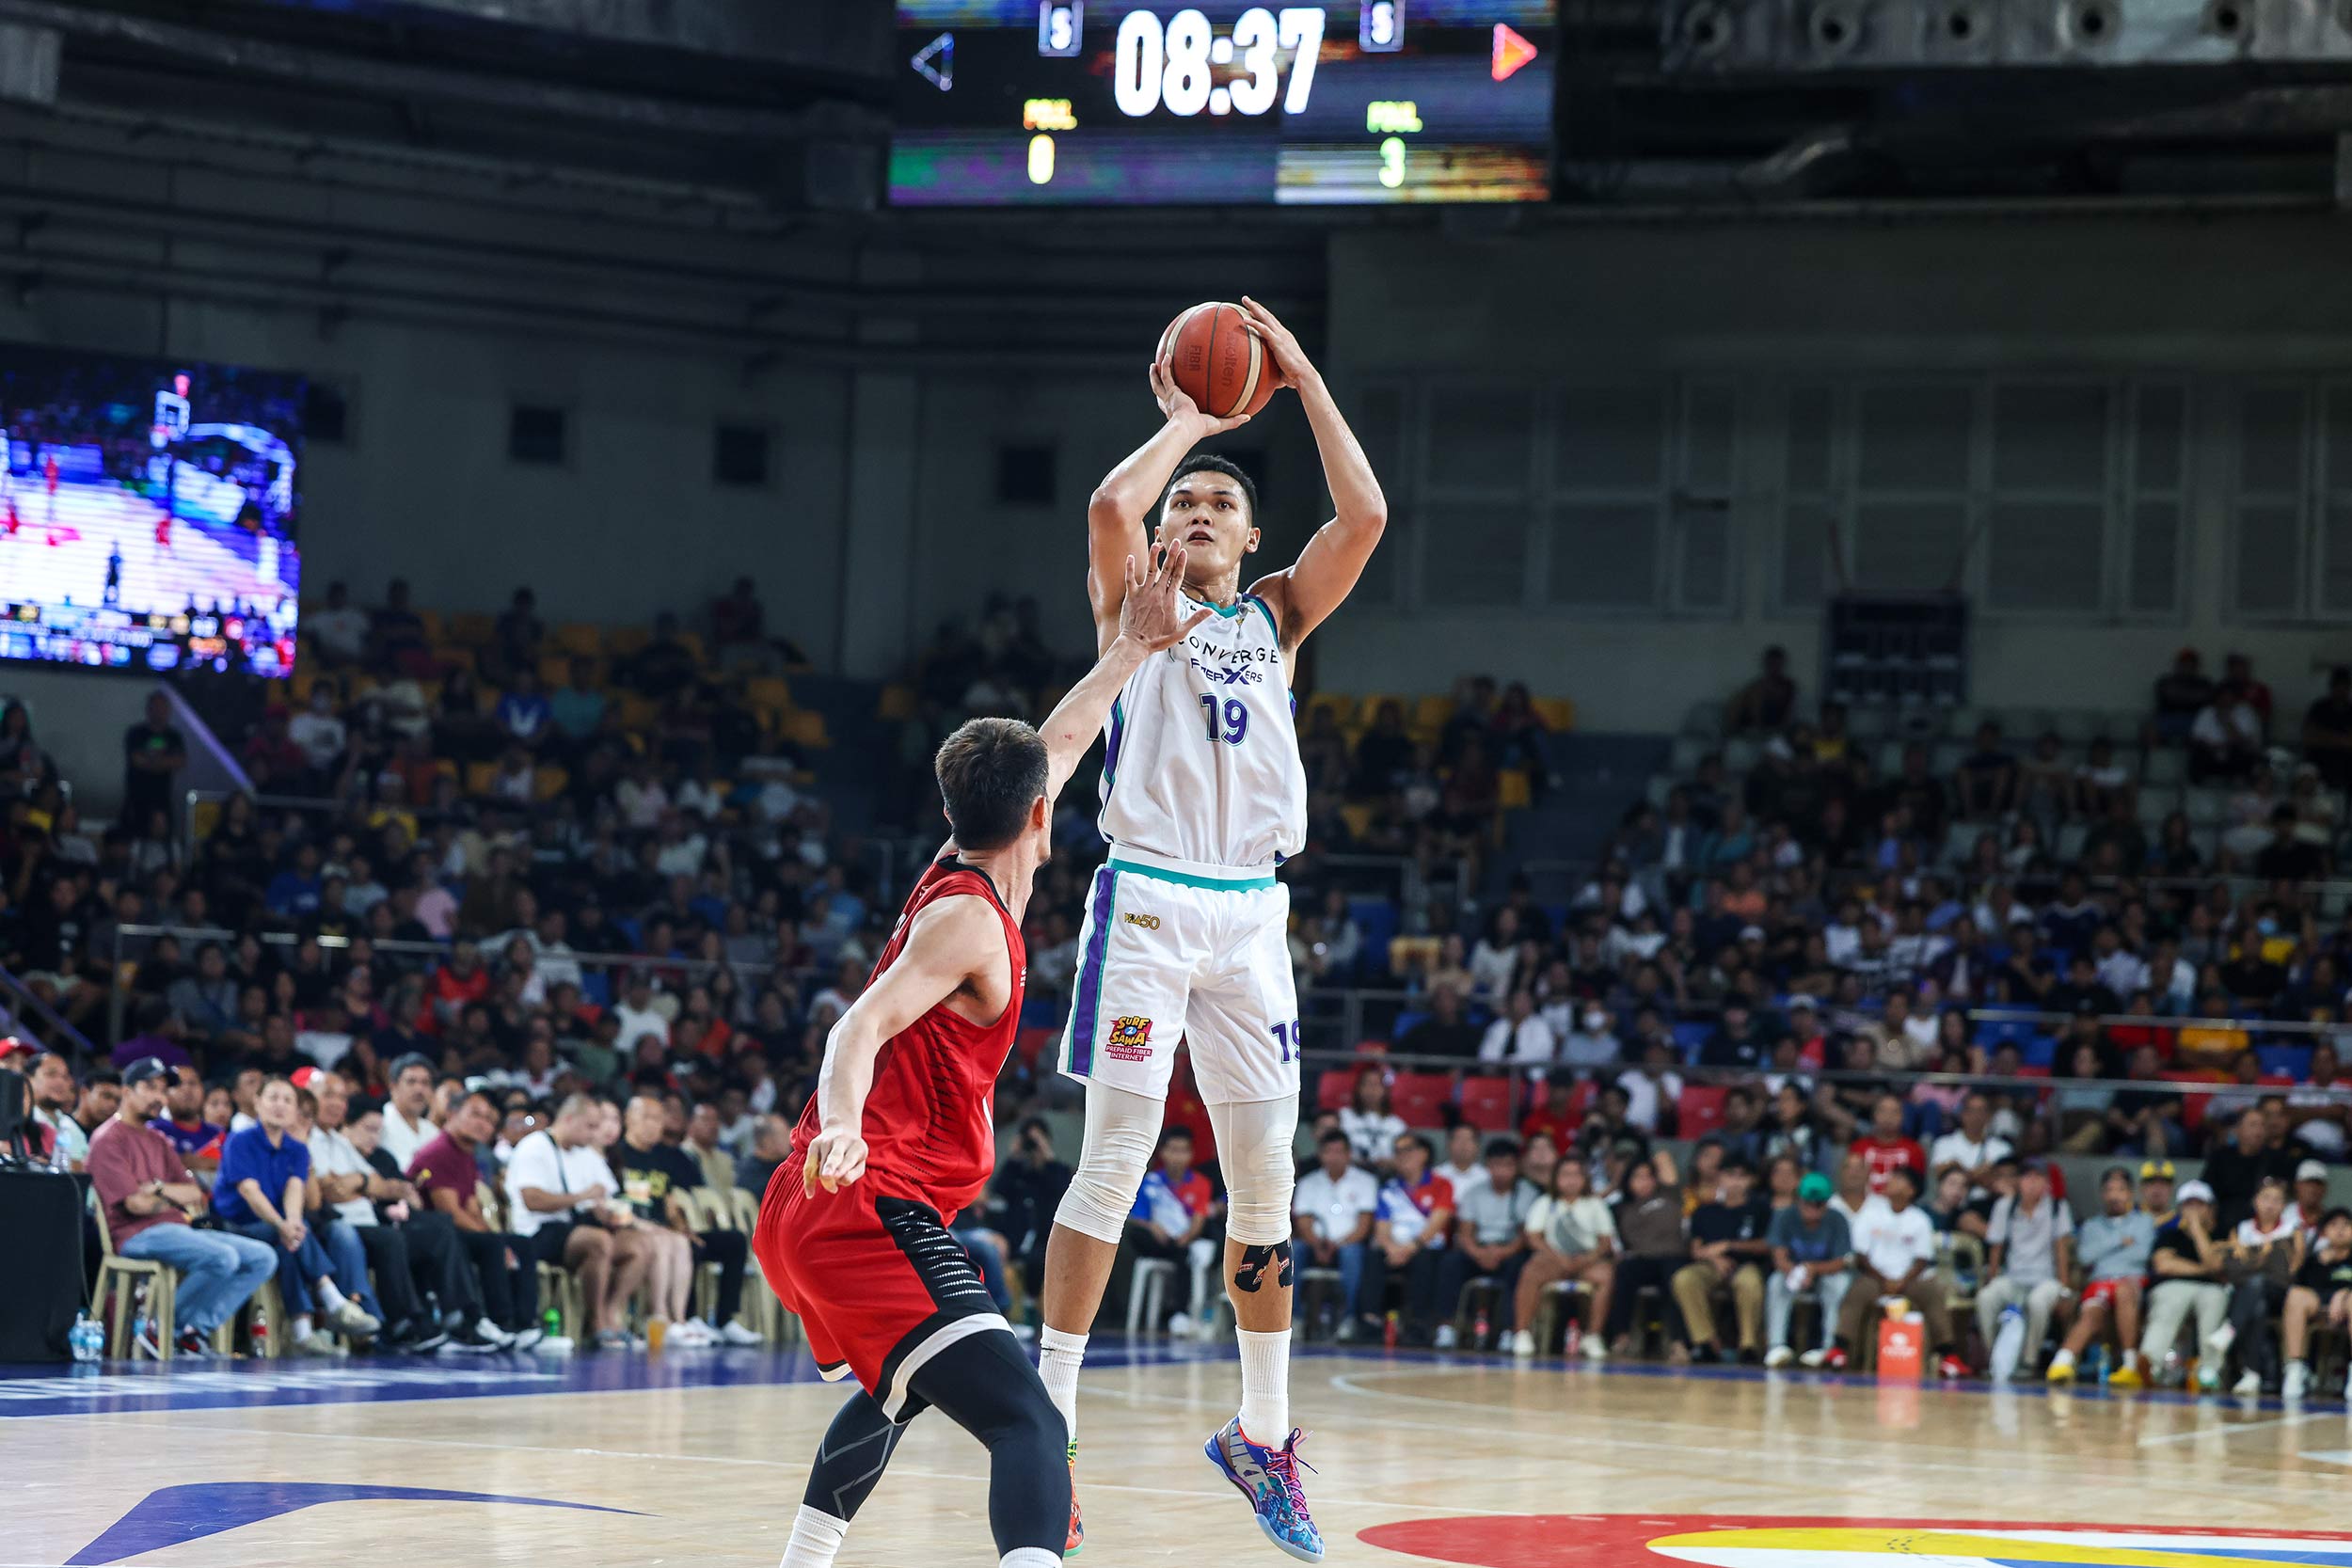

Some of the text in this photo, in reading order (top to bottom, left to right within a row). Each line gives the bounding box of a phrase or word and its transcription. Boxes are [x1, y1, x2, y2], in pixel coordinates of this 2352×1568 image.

[1115, 8, 1326, 117] 08:37
[1027, 135, 1055, 184] 0
[1378, 136, 1406, 188] 3
[1179, 636, 1279, 664] ONVERGE
[1199, 692, 1249, 747] 19
[1117, 1016, 1151, 1030] SURF
[1105, 1045, 1152, 1056] PREPAID FIBER
[1110, 1031, 1146, 1046] SAWA
[1111, 1052, 1144, 1061] INTERNET
